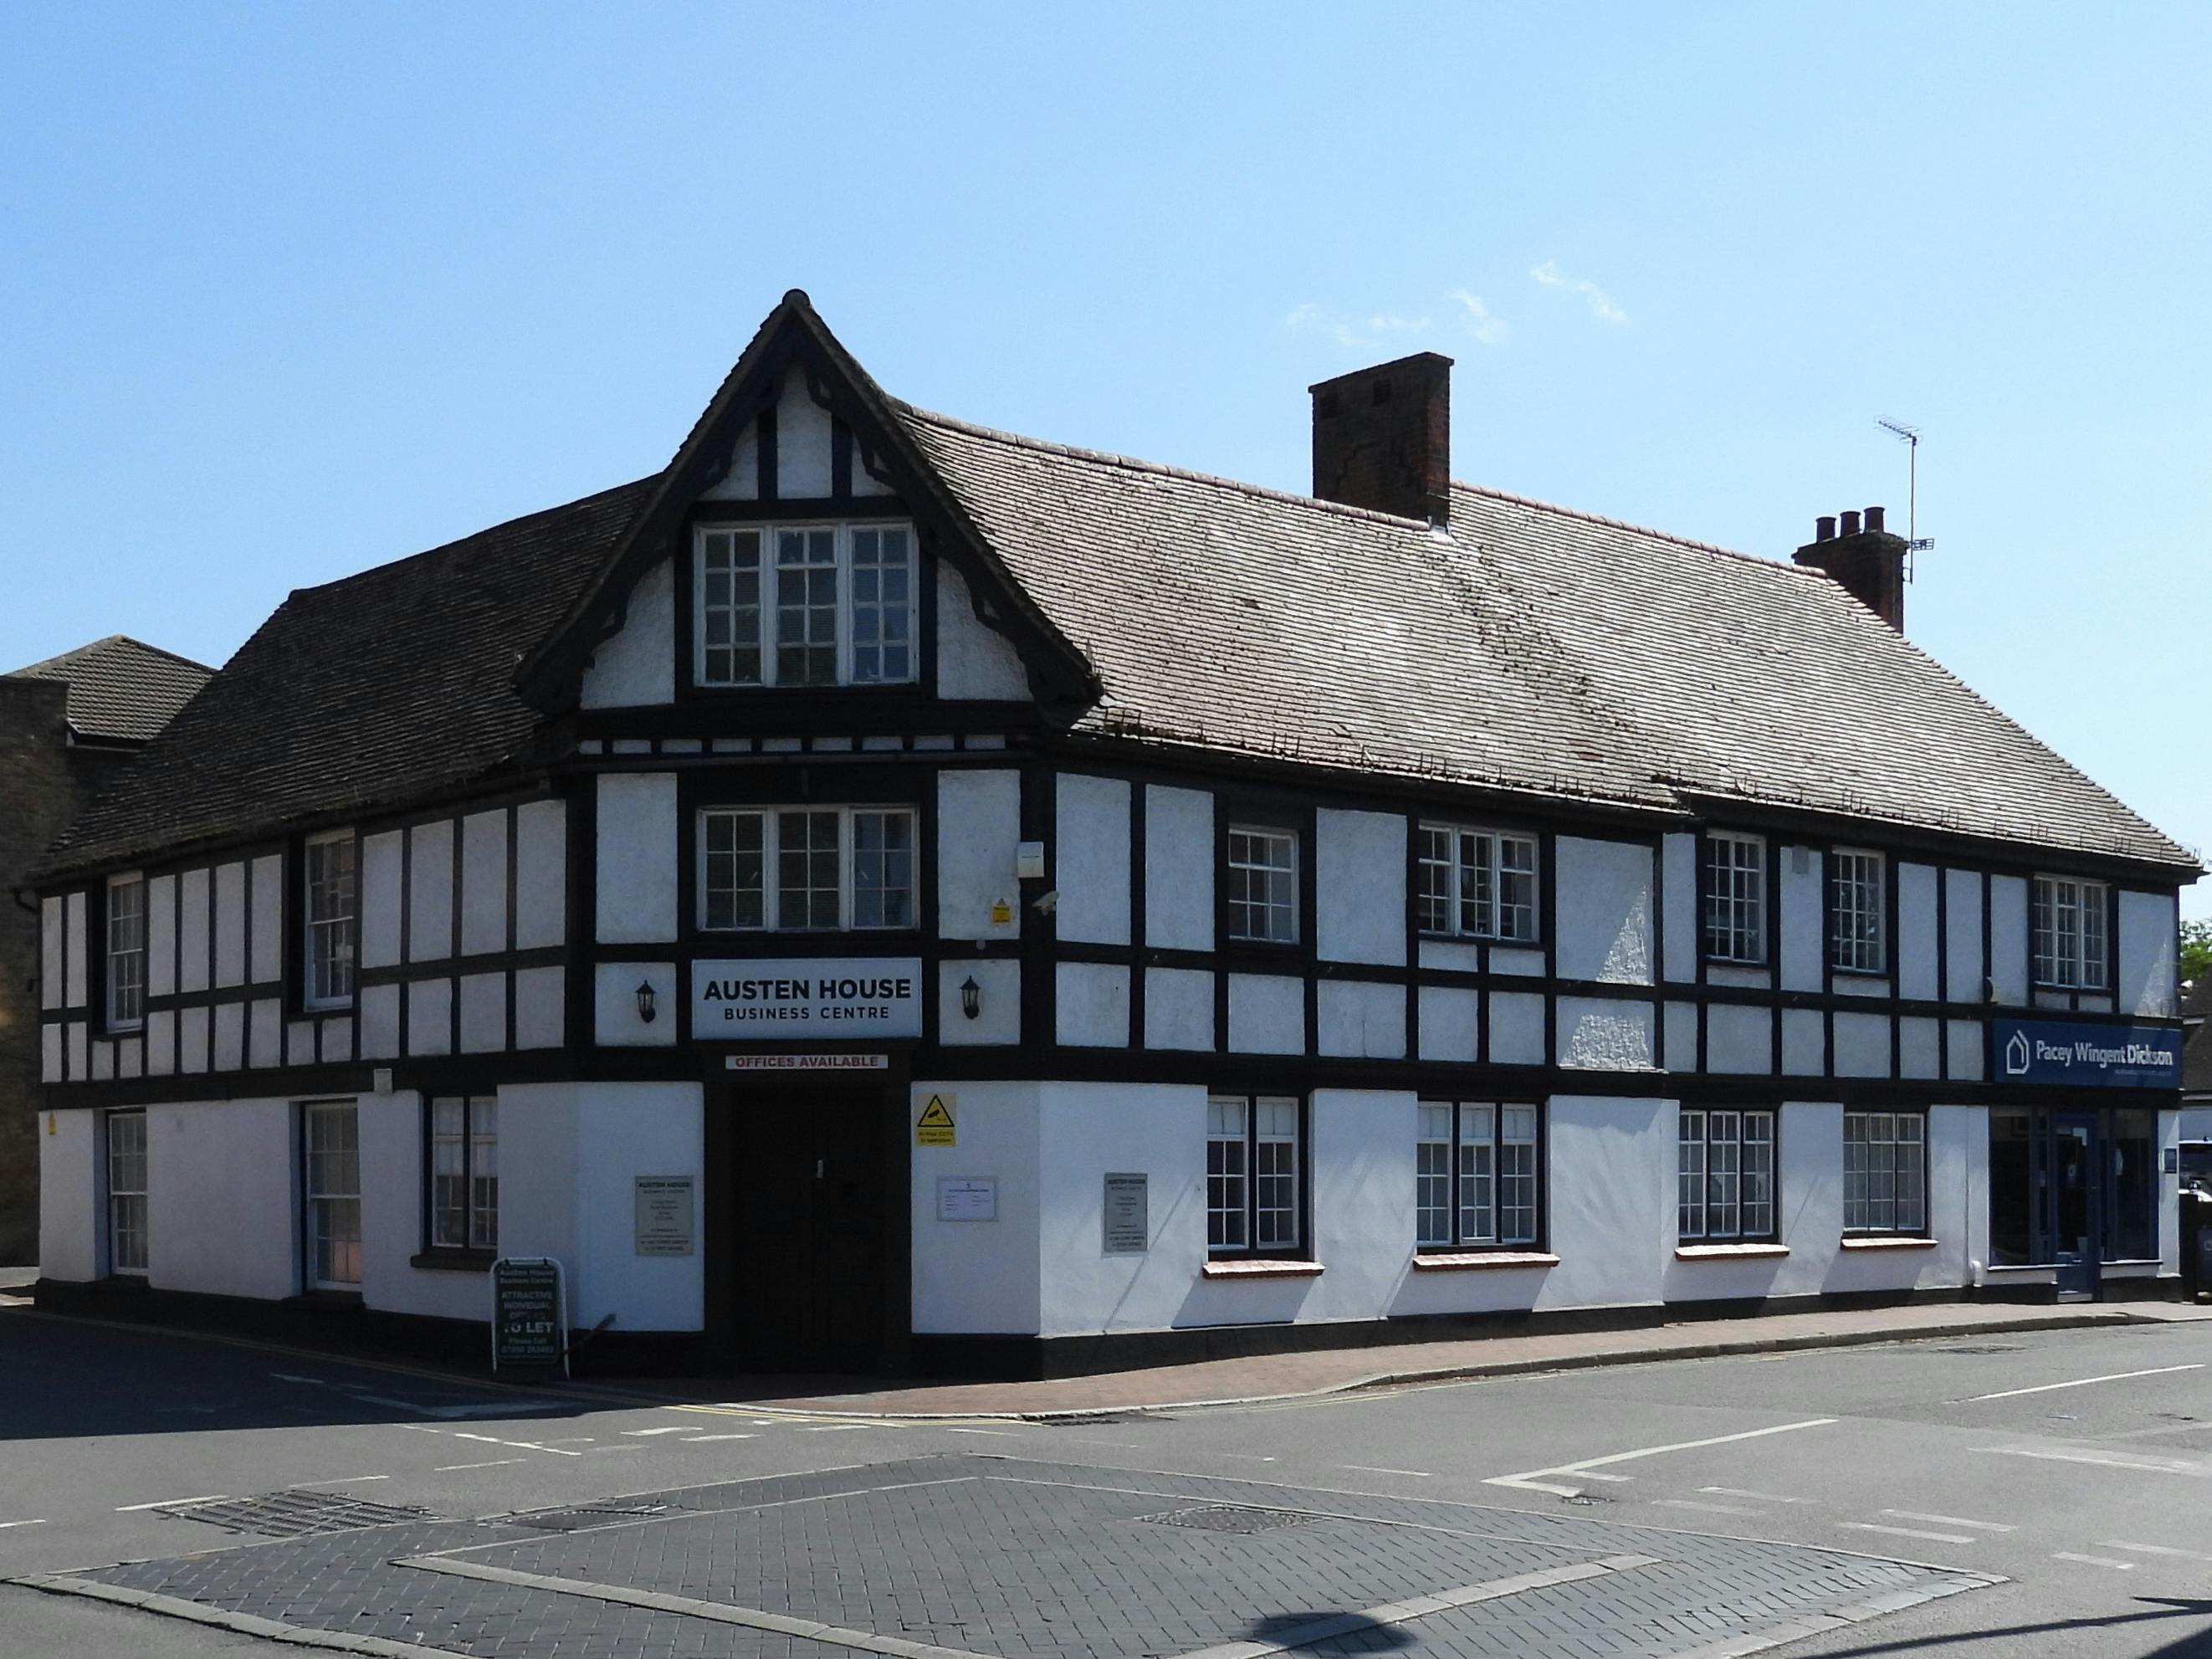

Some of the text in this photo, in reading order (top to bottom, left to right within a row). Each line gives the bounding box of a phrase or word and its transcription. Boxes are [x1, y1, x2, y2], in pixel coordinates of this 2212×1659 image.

[704, 979, 911, 1000] AUSTEN HOUSE
[725, 1006, 889, 1020] BUSINESS CENTRE
[2035, 1040, 2174, 1069] Pacey Wingent Dickson
[735, 1057, 878, 1068] OFFICES AVAILABLE
[502, 1291, 552, 1299] ATTRACTIVE
[504, 1301, 551, 1309] INDIVIDUAL
[525, 1321, 554, 1333] LET
